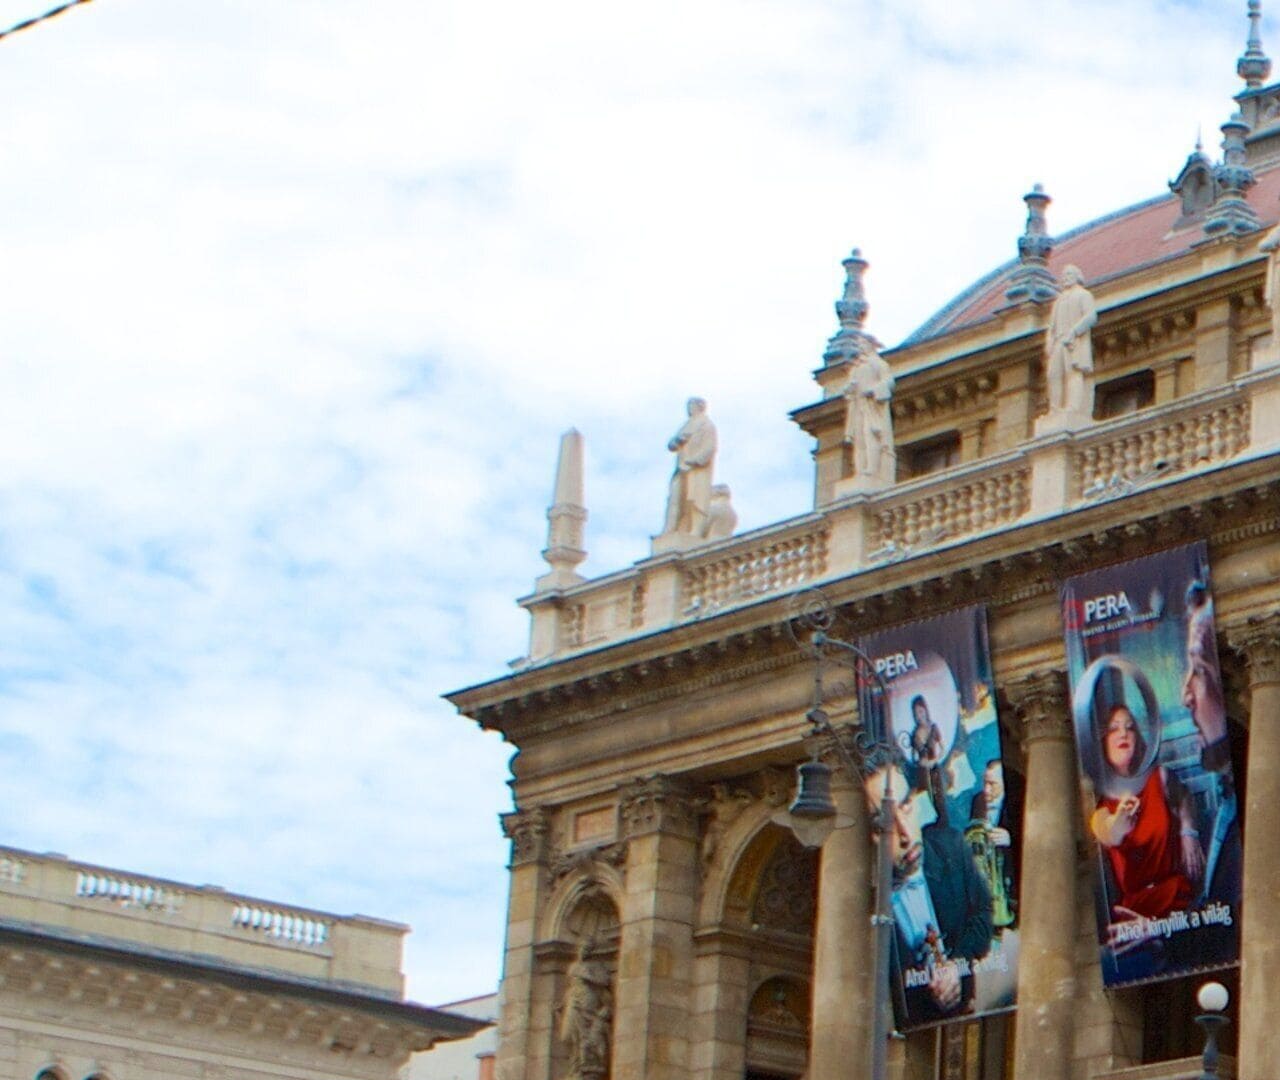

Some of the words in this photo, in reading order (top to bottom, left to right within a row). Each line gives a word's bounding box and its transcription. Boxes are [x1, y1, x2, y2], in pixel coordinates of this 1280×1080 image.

[1115, 921, 1145, 943] Ahol
[1190, 911, 1200, 929] a
[1201, 901, 1233, 927] világ
